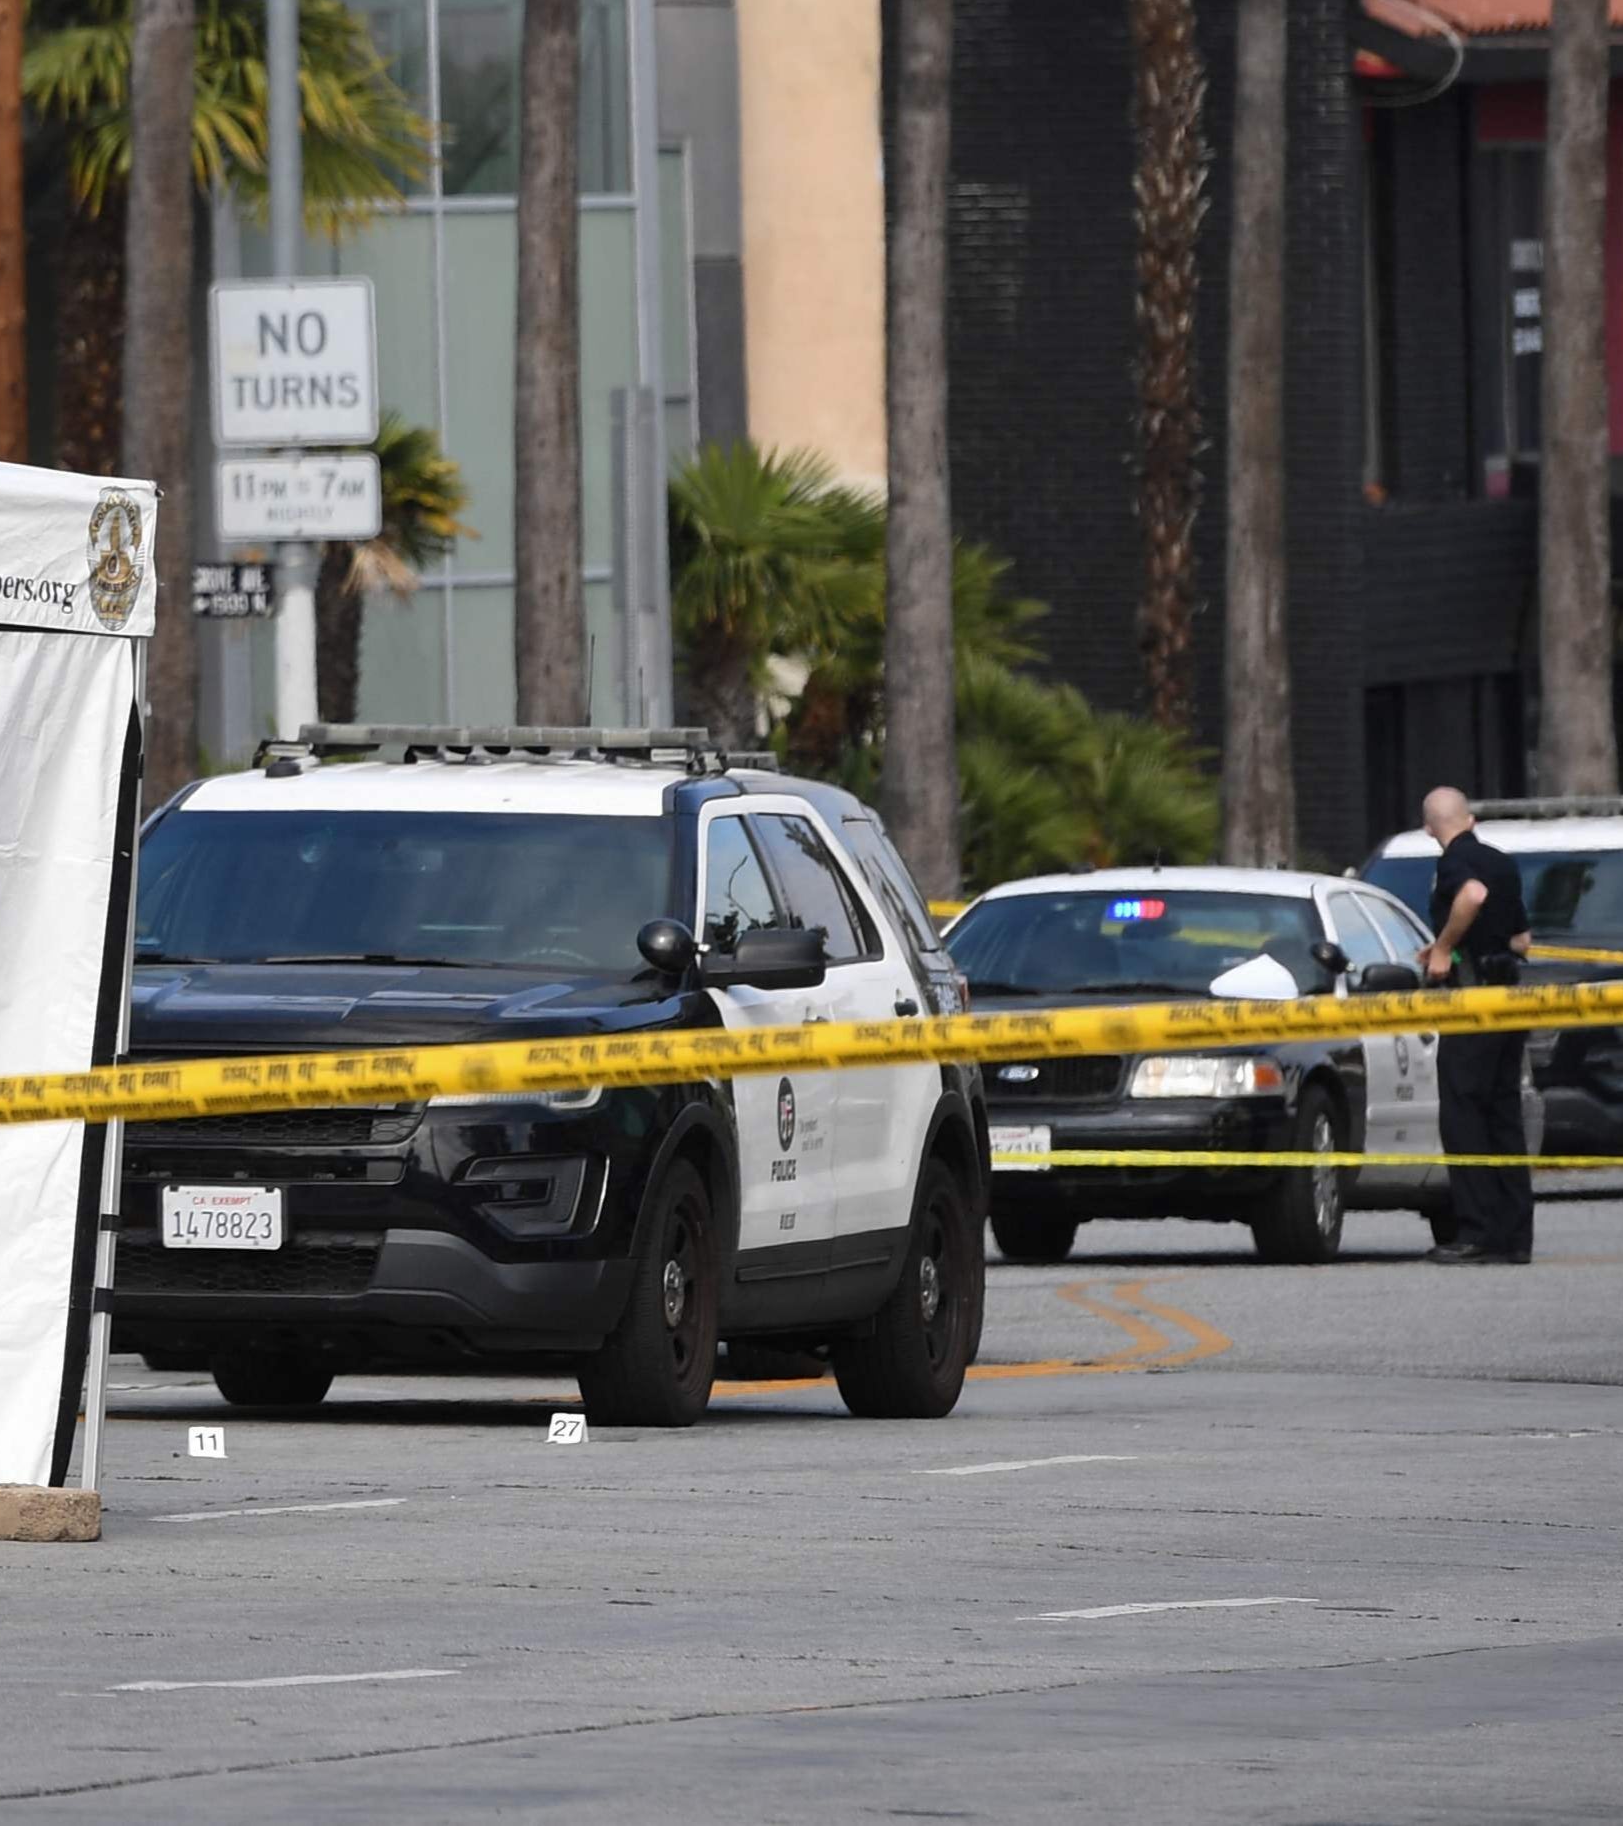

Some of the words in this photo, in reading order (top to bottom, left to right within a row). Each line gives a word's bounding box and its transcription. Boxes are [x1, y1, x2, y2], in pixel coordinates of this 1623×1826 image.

[258, 311, 327, 356] NO
[232, 375, 360, 410] TURNS
[193, 1196, 206, 1205] CA
[212, 1197, 251, 1205] EXEMPT
[172, 1211, 272, 1239] 1478823
[552, 1420, 581, 1437] 27
[195, 1433, 218, 1451] 11
